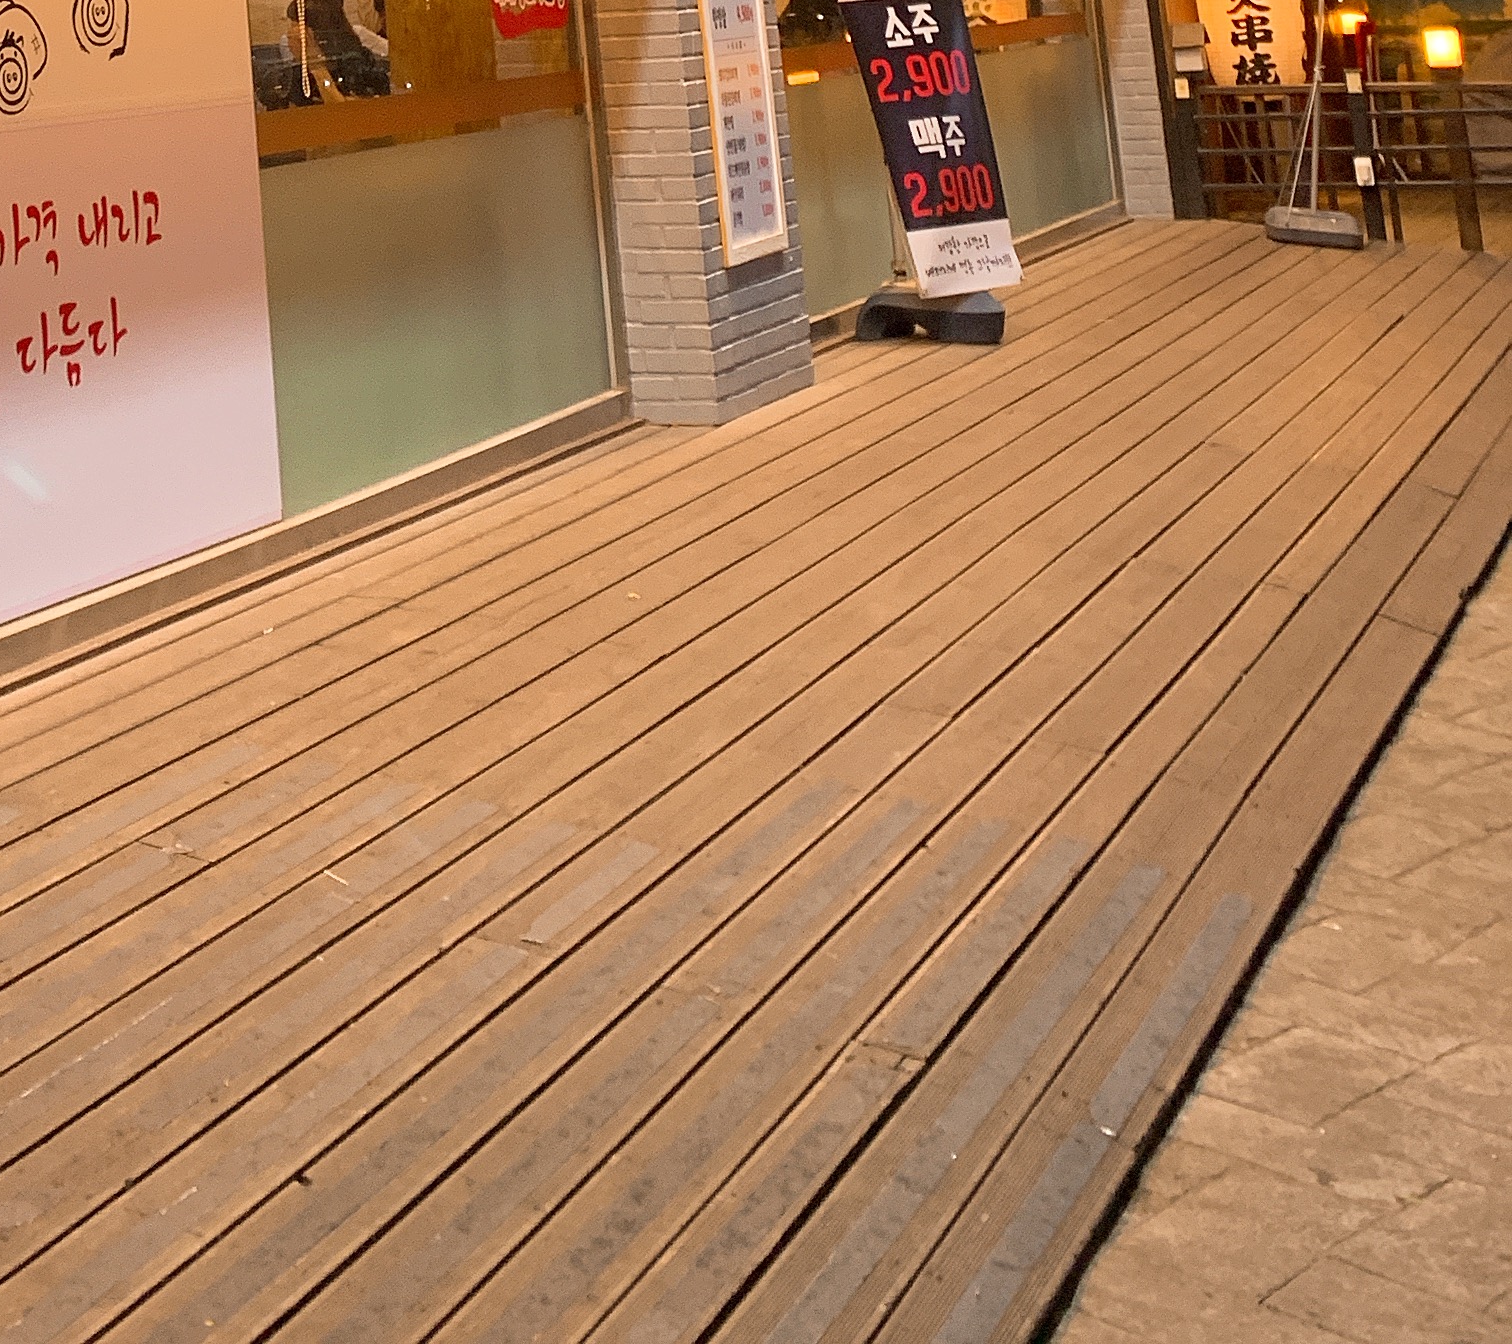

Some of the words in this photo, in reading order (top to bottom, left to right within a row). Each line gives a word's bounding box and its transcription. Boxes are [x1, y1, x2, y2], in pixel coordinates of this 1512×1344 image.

[884, 4, 940, 49] 소주
[870, 50, 970, 103] 2,900
[908, 115, 967, 160] 맥주
[904, 164, 993, 220] 2,900
[79, 190, 161, 249] 내리고
[16, 297, 128, 387] 다듬다
